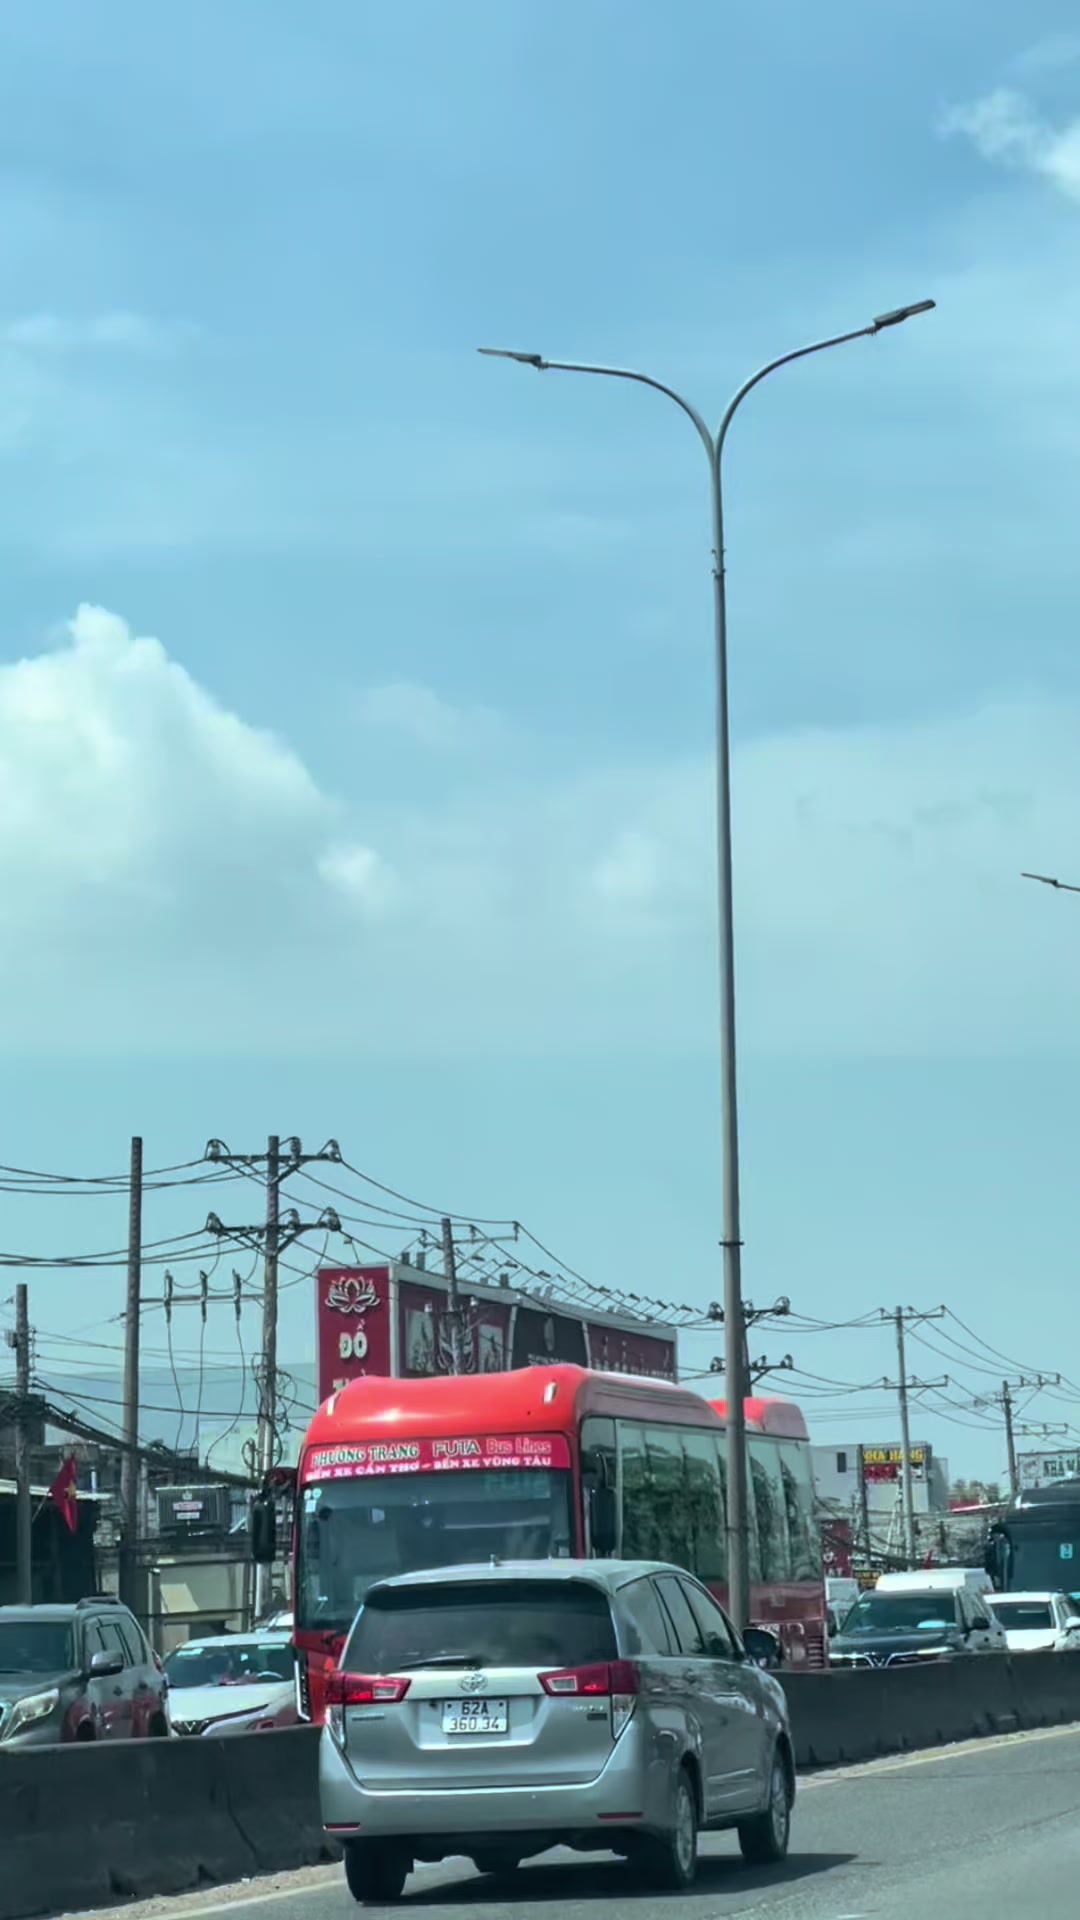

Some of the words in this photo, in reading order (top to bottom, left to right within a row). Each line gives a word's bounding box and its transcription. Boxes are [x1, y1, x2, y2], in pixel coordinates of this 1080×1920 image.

[369, 1442, 419, 1461] TRANG
[433, 1440, 481, 1457] FUTA
[486, 1438, 512, 1454] Bus
[516, 1437, 552, 1454] Lines
[334, 1467, 352, 1477] XE
[355, 1460, 386, 1475] CẦN
[389, 1461, 419, 1473] THƠ
[434, 1456, 459, 1470] BẾN
[462, 1459, 480, 1468] XE
[483, 1455, 519, 1467] VŨNG
[523, 1455, 551, 1466] TÀU
[461, 1701, 489, 1715] 62A
